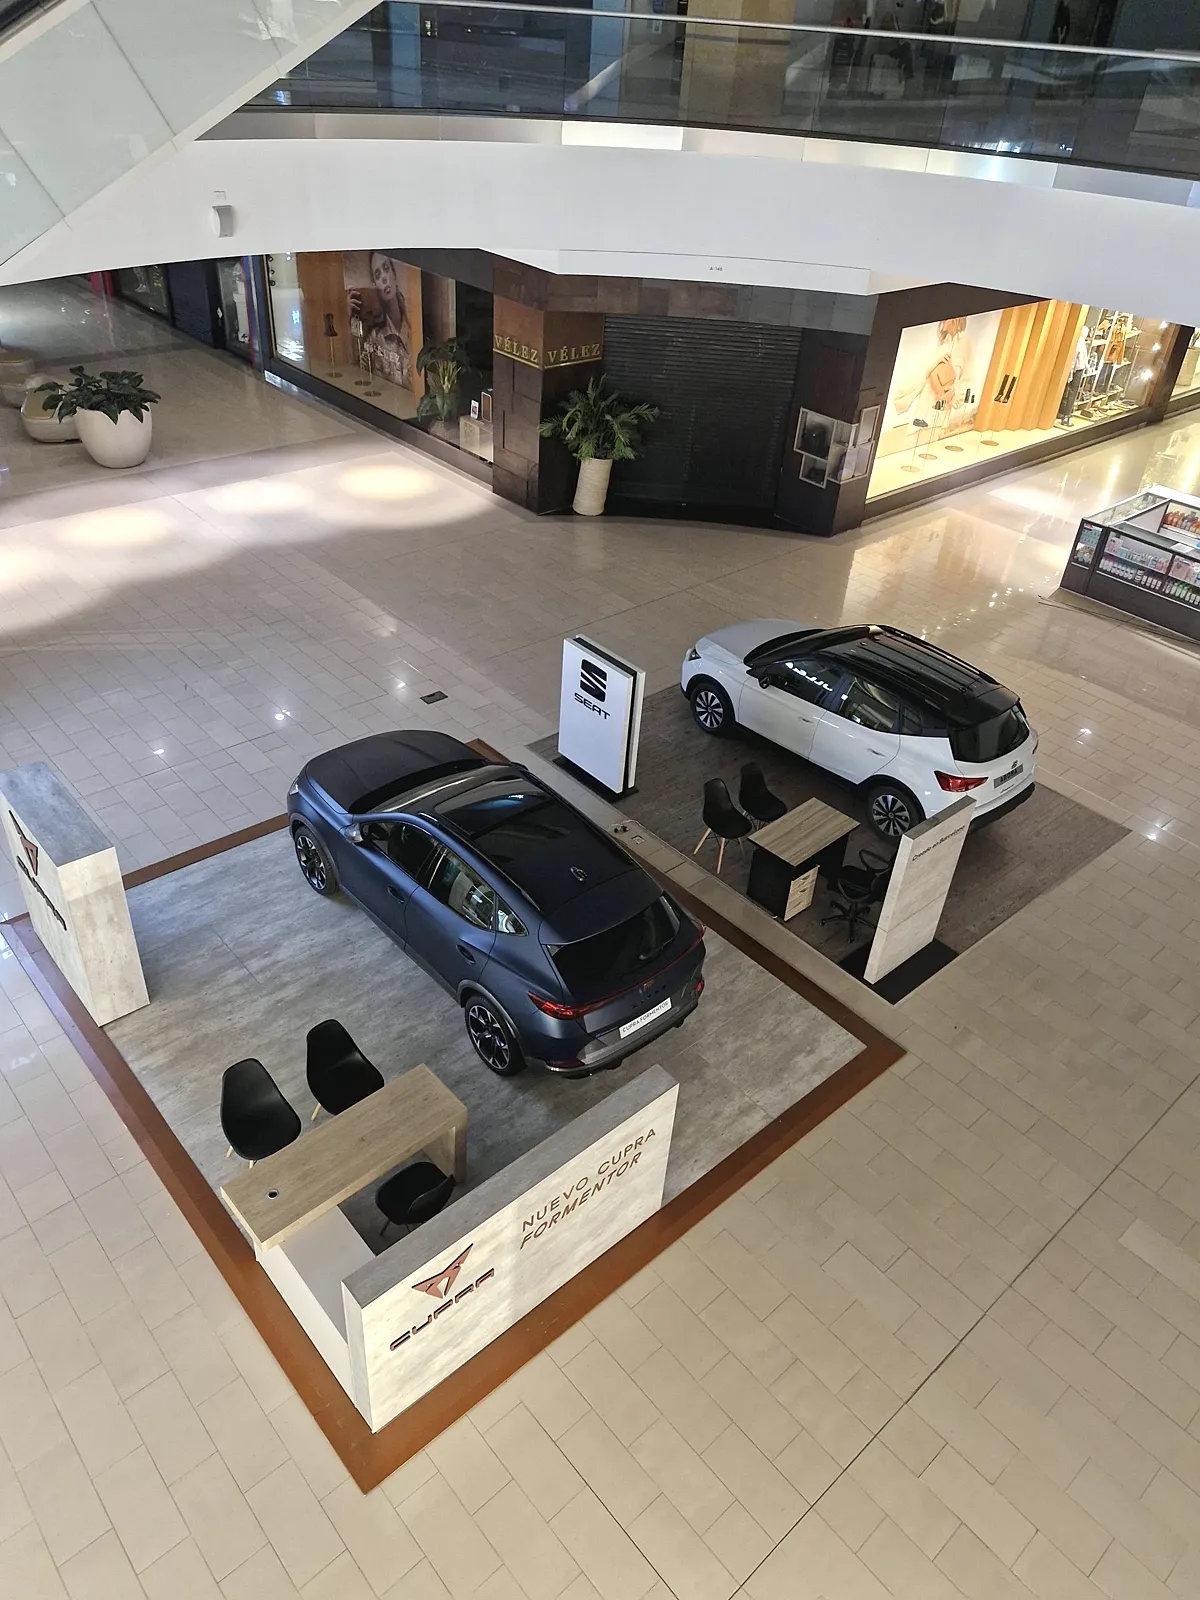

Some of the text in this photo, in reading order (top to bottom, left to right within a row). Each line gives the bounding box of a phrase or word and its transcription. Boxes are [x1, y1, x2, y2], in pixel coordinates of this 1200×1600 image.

[494, 335, 538, 362] VÉLEZ
[547, 343, 600, 362] VÉLEZ
[574, 692, 611, 720] SEAT
[622, 1000, 669, 1032] CUPRA FORMENTOR
[522, 1128, 656, 1232] NUEVO CUPRA
[519, 1151, 642, 1250] FORMENTOR
[389, 1267, 495, 1352] CUPRA
